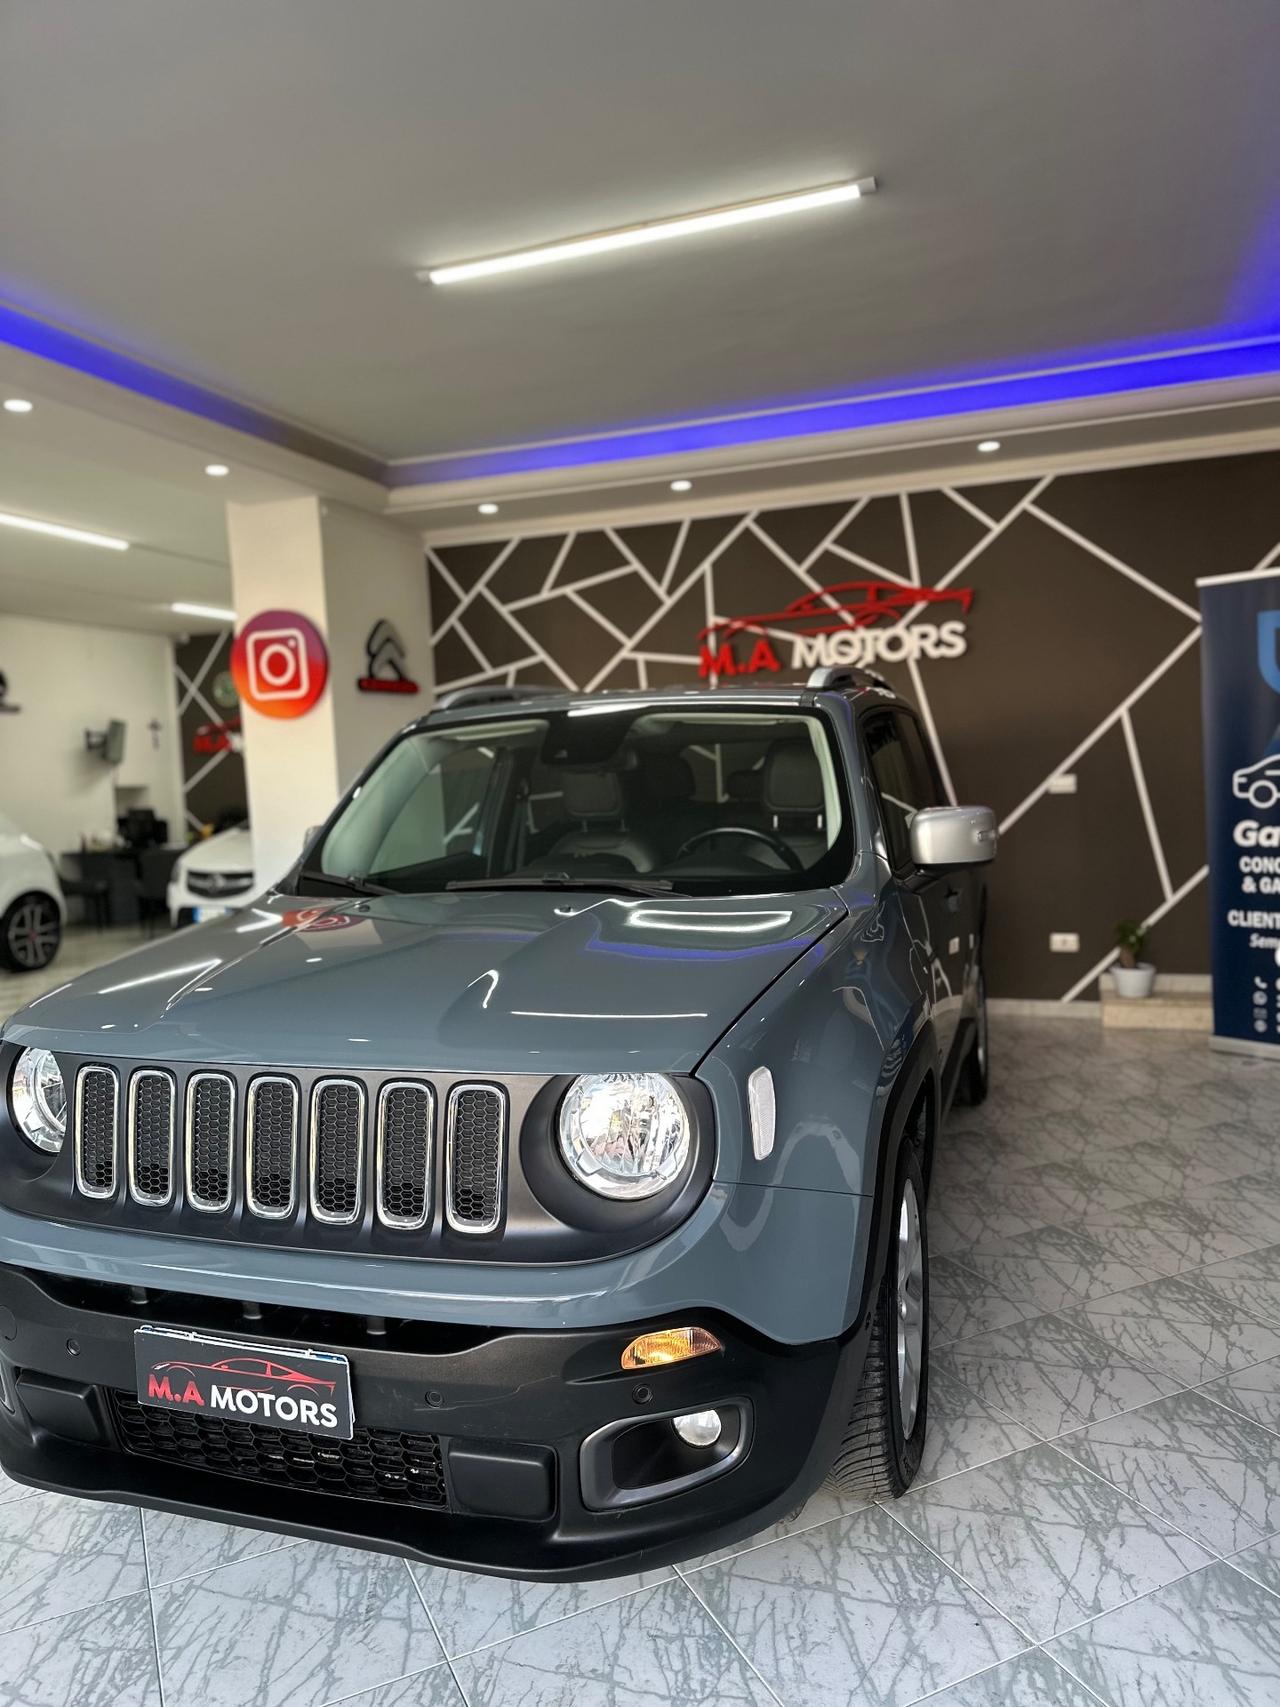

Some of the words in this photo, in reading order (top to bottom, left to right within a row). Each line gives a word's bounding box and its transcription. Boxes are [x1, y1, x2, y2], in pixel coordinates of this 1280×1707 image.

[699, 639, 781, 677] M.A
[791, 620, 967, 669] MOTORS
[148, 1374, 205, 1406] M.A
[210, 1384, 338, 1428] MOTORS
